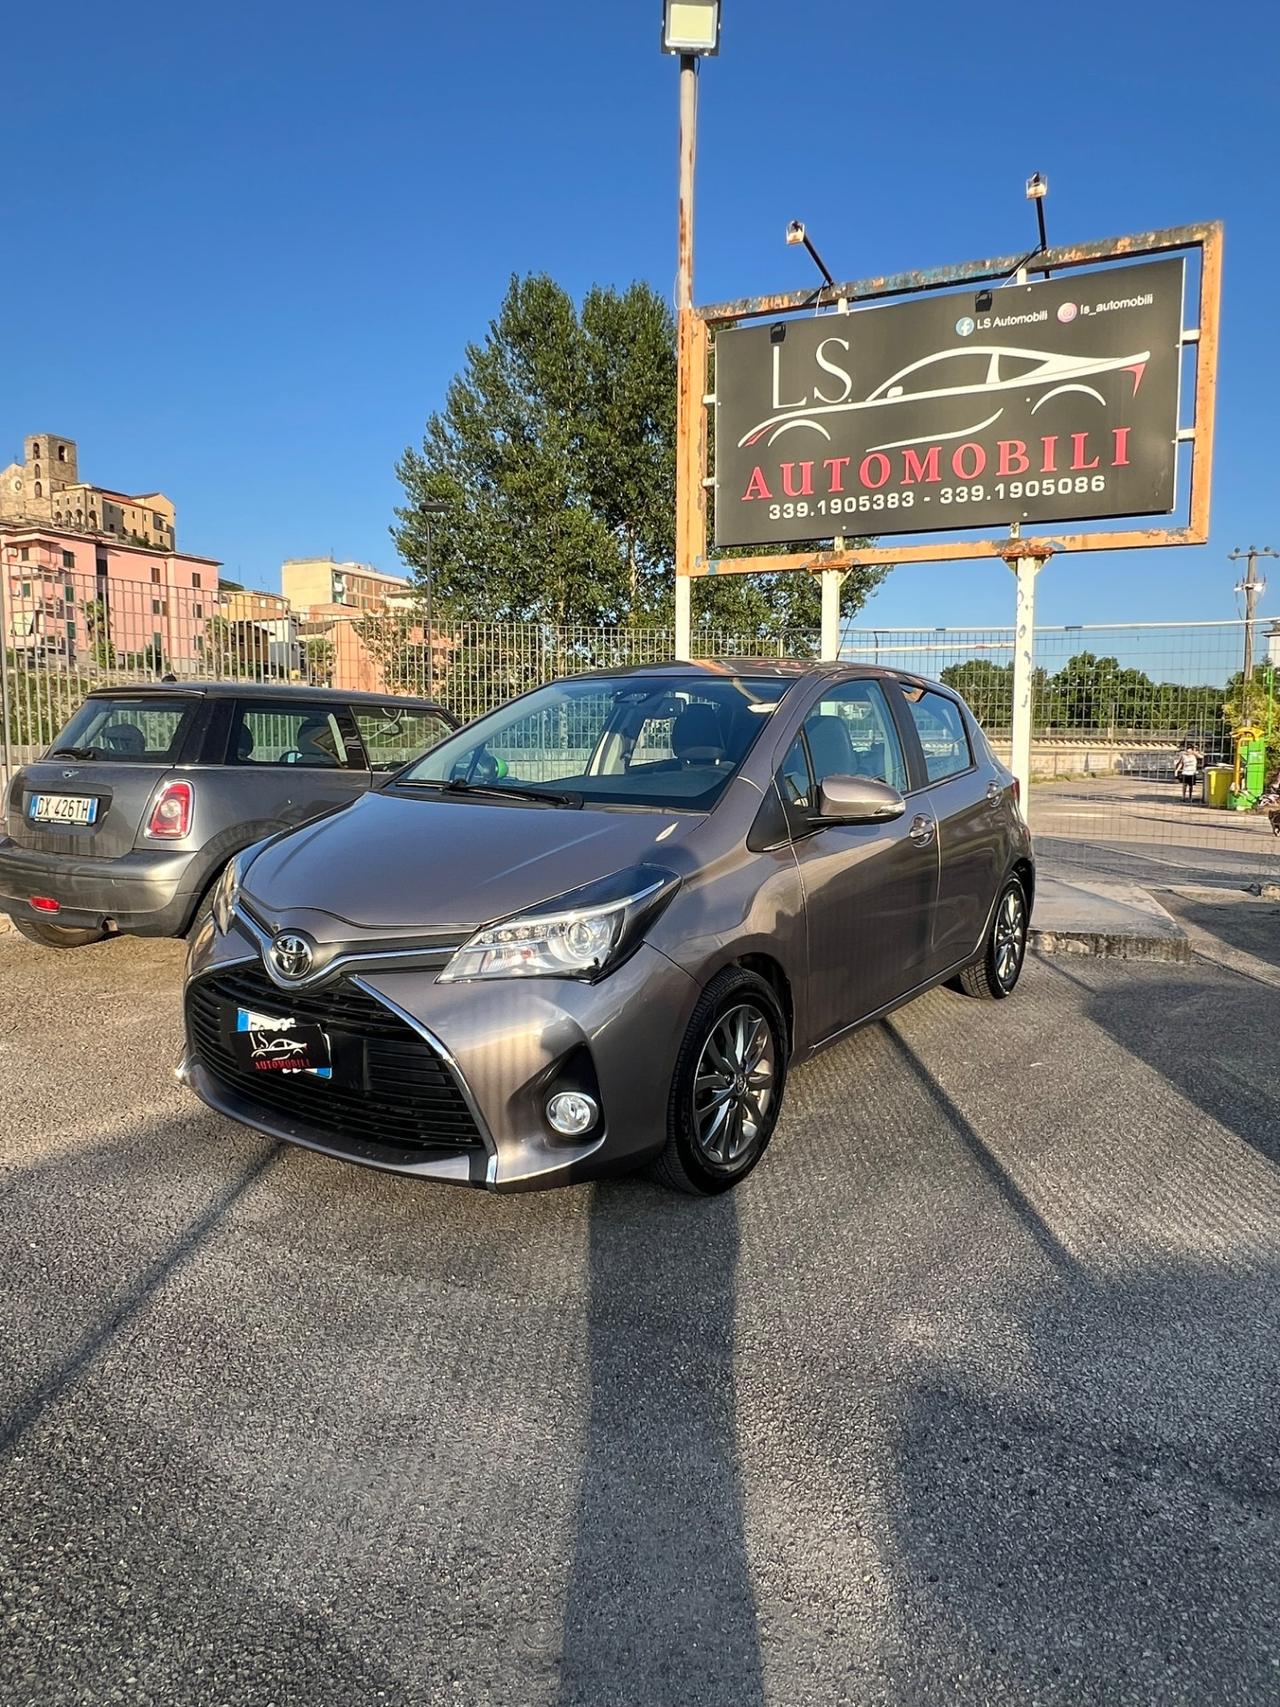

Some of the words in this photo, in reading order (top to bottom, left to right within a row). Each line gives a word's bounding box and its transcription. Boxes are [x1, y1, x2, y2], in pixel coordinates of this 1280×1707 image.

[976, 316, 992, 330] LS
[993, 309, 1049, 328] Automobili
[740, 426, 1132, 501] AUTOMOBILI
[768, 491, 915, 520] 339.1905383
[939, 475, 1106, 504] 339.1905086
[37, 797, 52, 816] DX
[54, 799, 90, 819] 426TH
